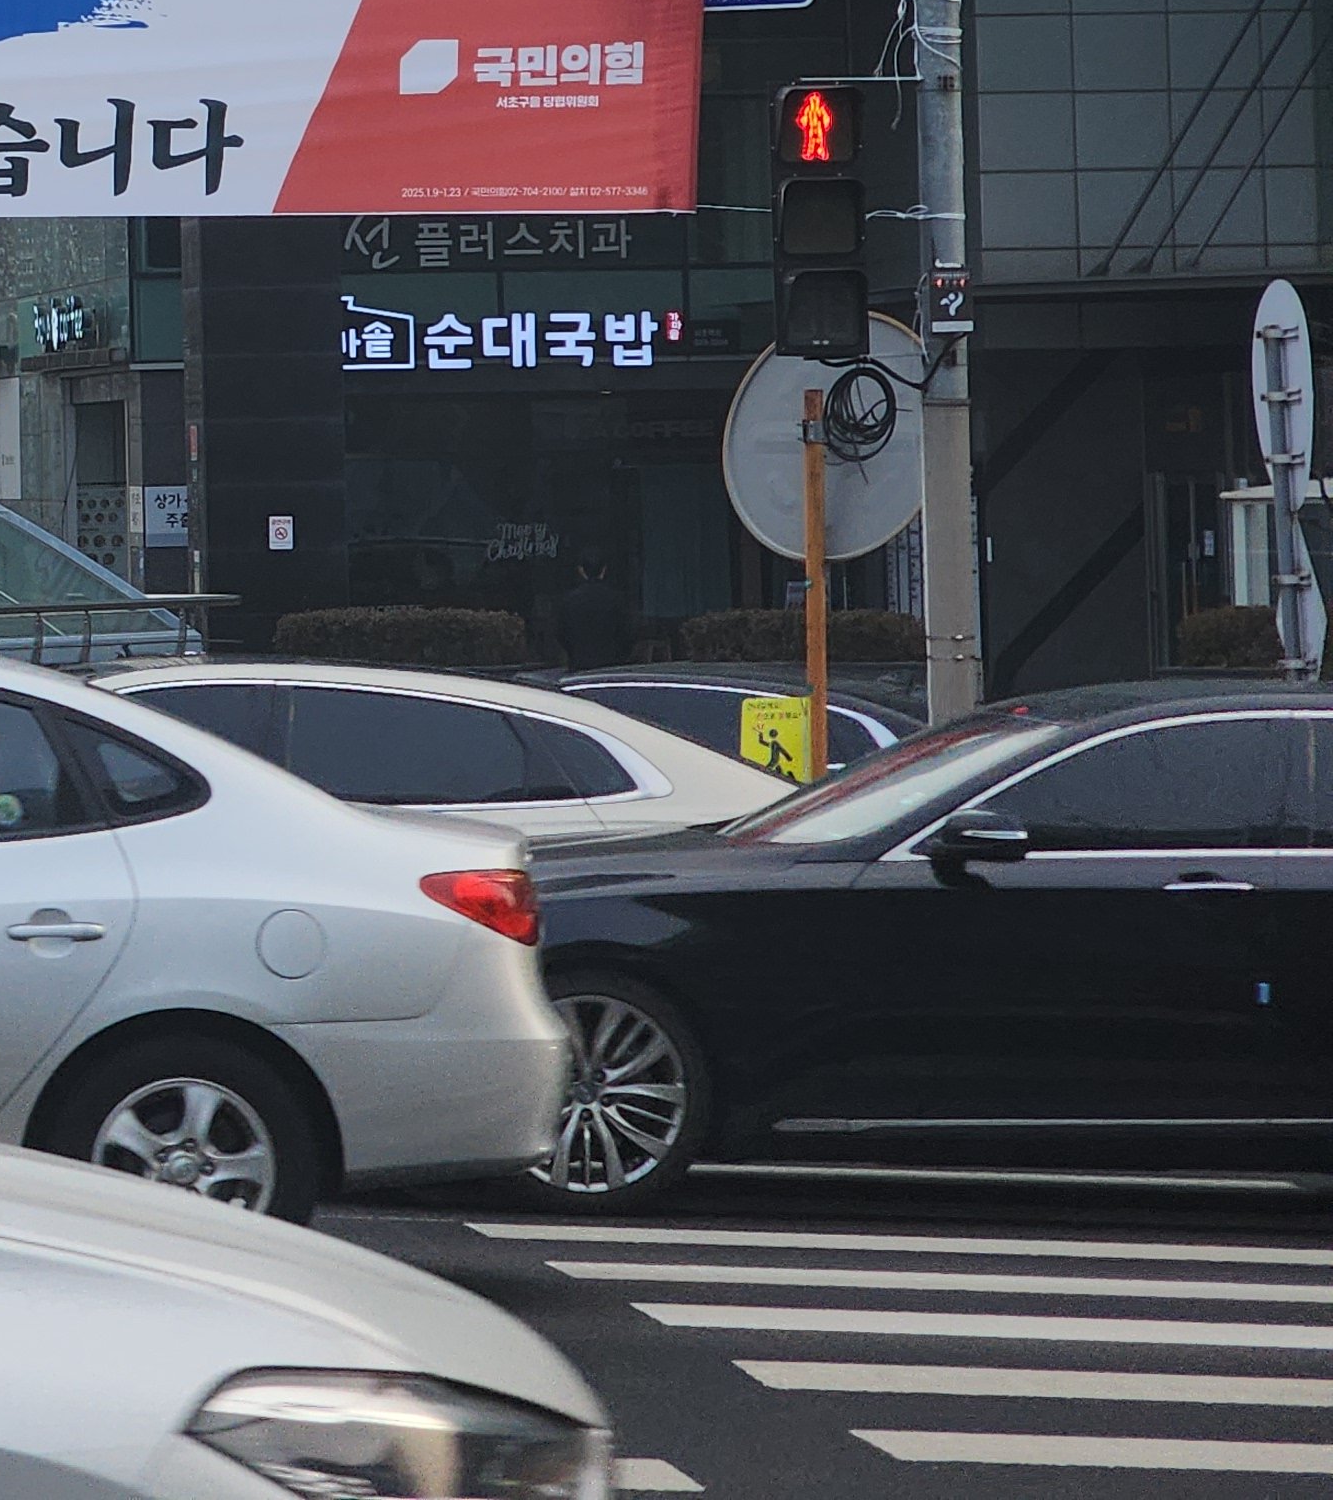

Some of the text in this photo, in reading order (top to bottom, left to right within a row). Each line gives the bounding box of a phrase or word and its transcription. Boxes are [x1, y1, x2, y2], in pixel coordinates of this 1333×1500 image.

[473, 41, 645, 87] 국민의힘
[343, 214, 633, 269] 선 플러스치과
[423, 310, 659, 370] 순대국밥
[154, 493, 181, 509] 상가
